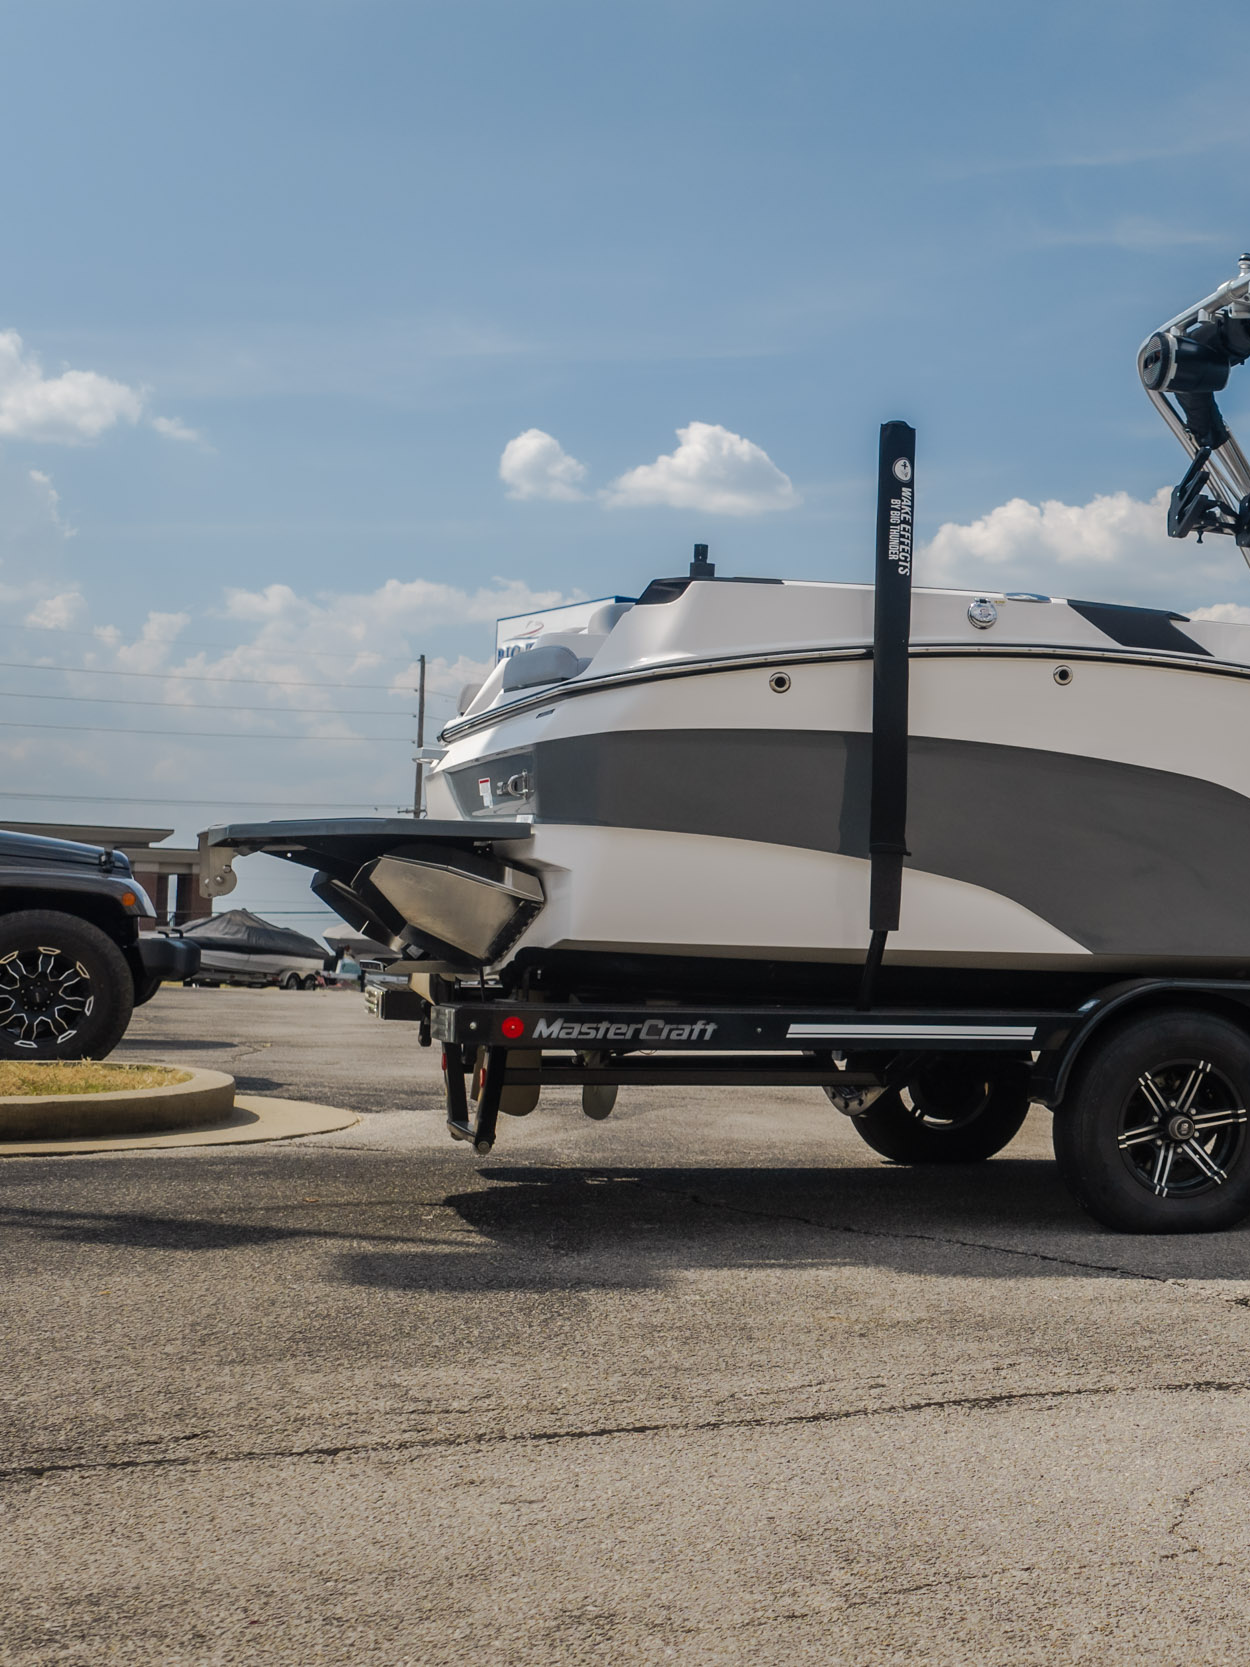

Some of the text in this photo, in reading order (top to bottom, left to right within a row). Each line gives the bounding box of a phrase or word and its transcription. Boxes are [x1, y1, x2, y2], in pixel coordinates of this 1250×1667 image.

[888, 498, 901, 560] BY BIG THUNDER
[898, 487, 913, 576] WAKE EFFECTS
[532, 1017, 718, 1041] MasterCraft
